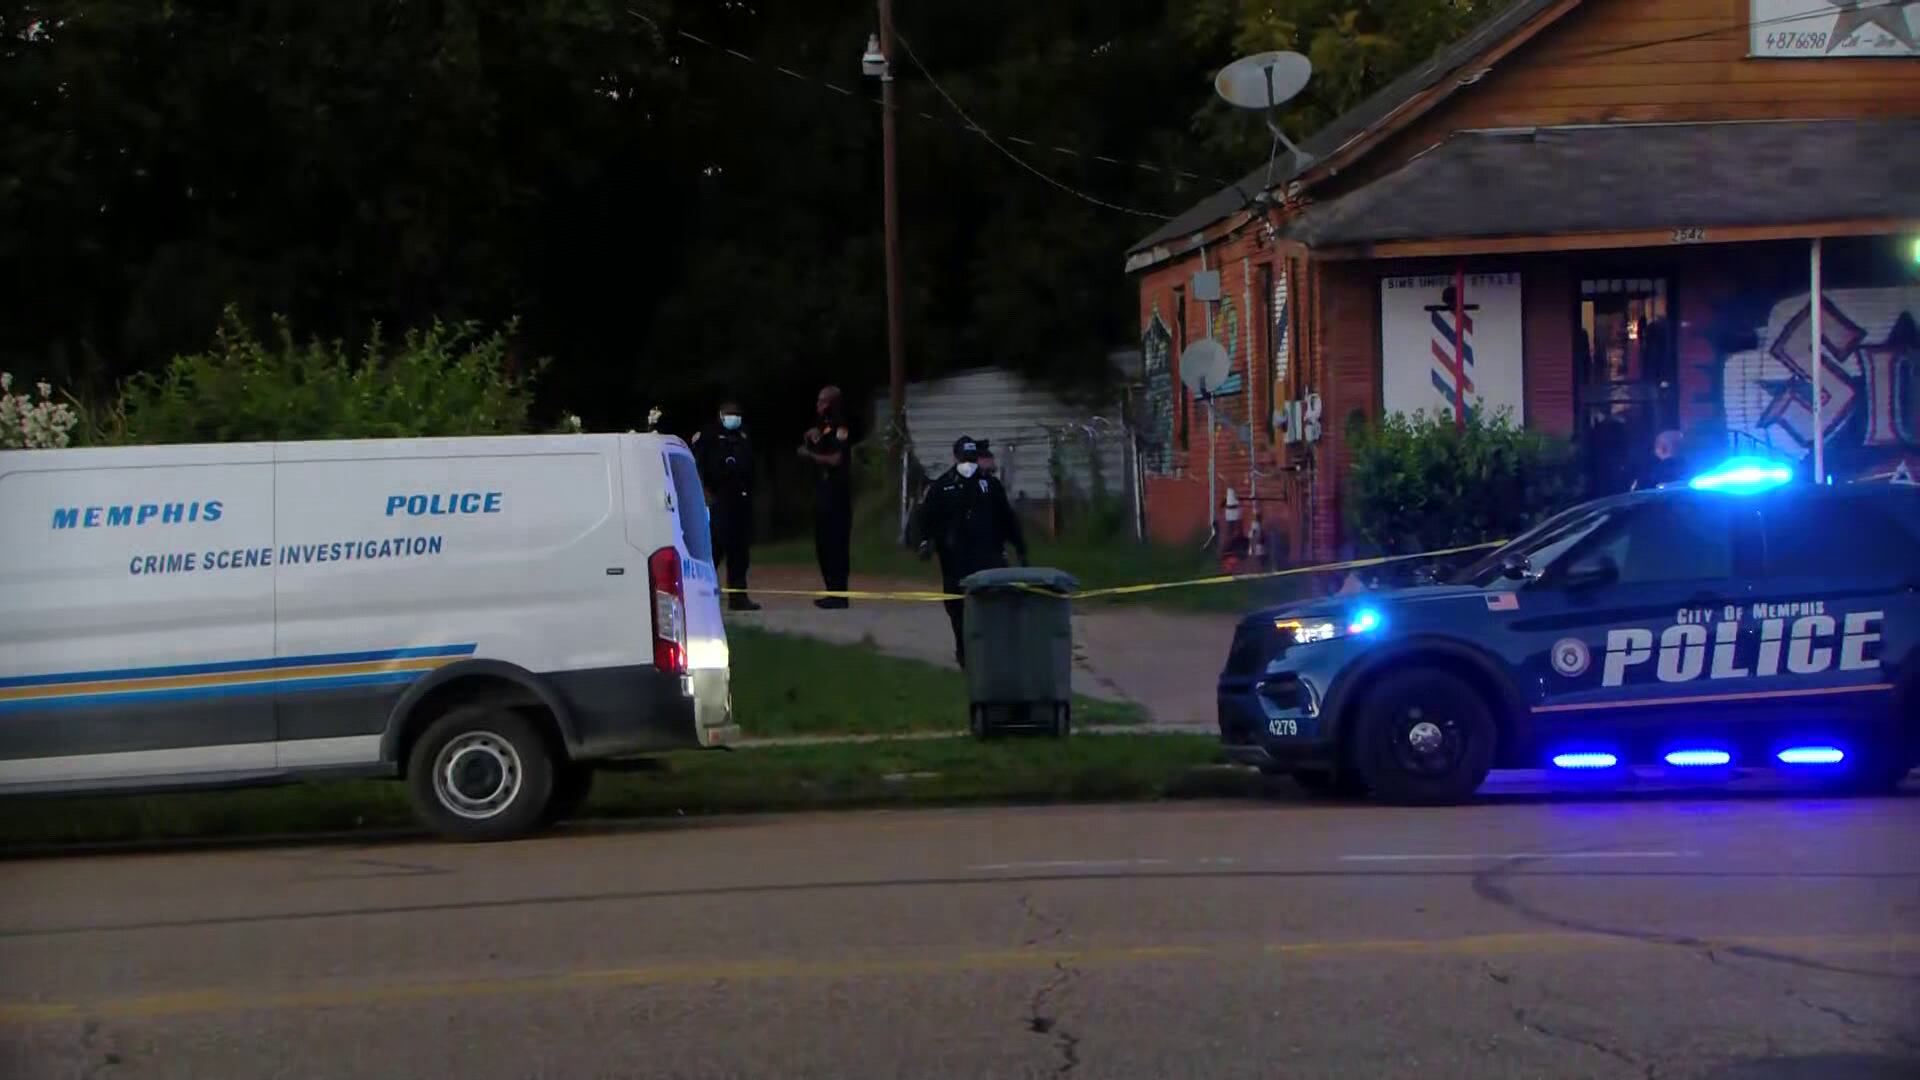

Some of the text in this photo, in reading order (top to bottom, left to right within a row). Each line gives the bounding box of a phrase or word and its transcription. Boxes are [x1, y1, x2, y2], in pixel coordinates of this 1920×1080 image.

[52, 492, 502, 529] MEMPHIS POLICE
[130, 536, 443, 575] CRIME SCENE INVESTIGATION
[1677, 607, 1713, 625] CITY
[1753, 601, 1825, 619] MEMPHIS
[1602, 611, 1884, 687] POLICE
[1269, 720, 1297, 735] 4279
